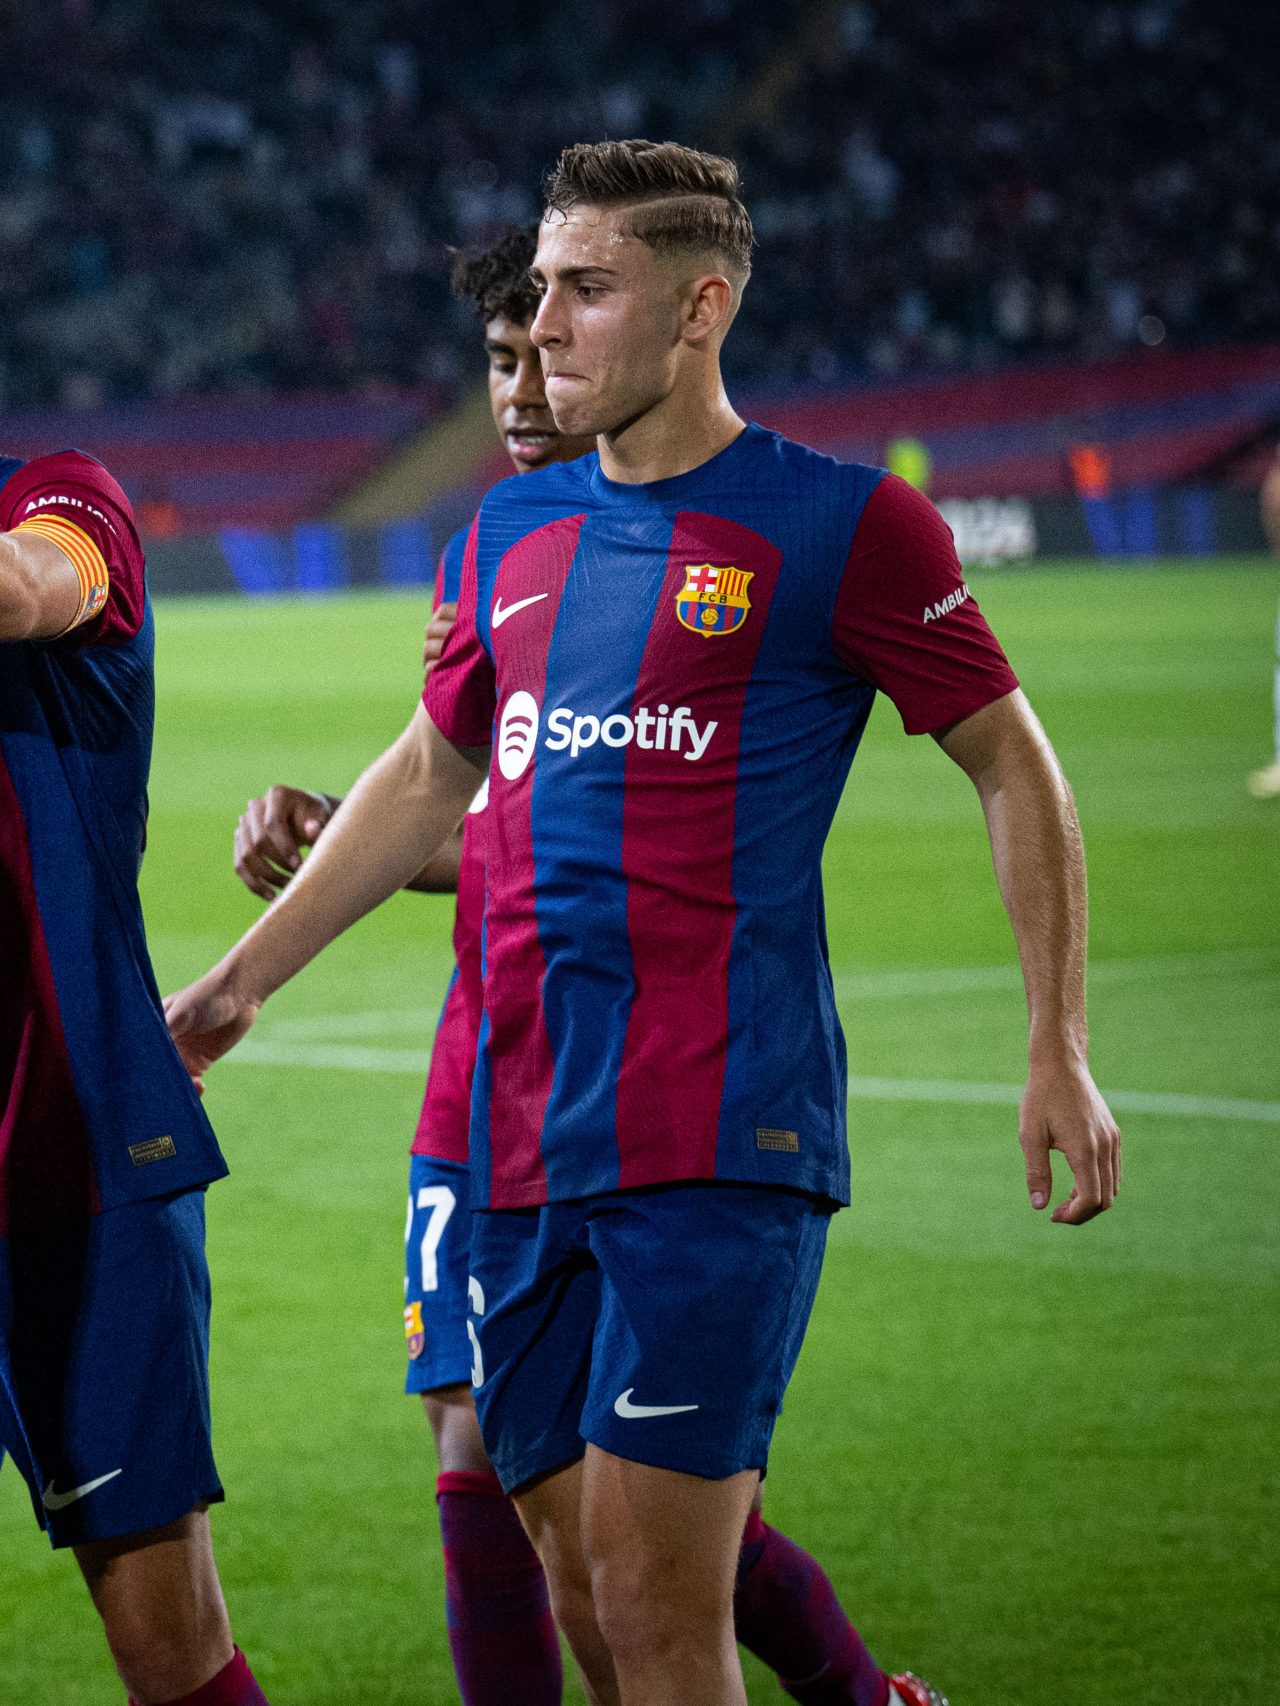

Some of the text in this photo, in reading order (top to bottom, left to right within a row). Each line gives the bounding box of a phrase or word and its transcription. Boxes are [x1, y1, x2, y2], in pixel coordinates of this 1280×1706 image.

[699, 593, 728, 604] FCB
[923, 583, 971, 624] AMBILI
[545, 703, 719, 762] Spotify
[404, 1185, 456, 1292] 7
